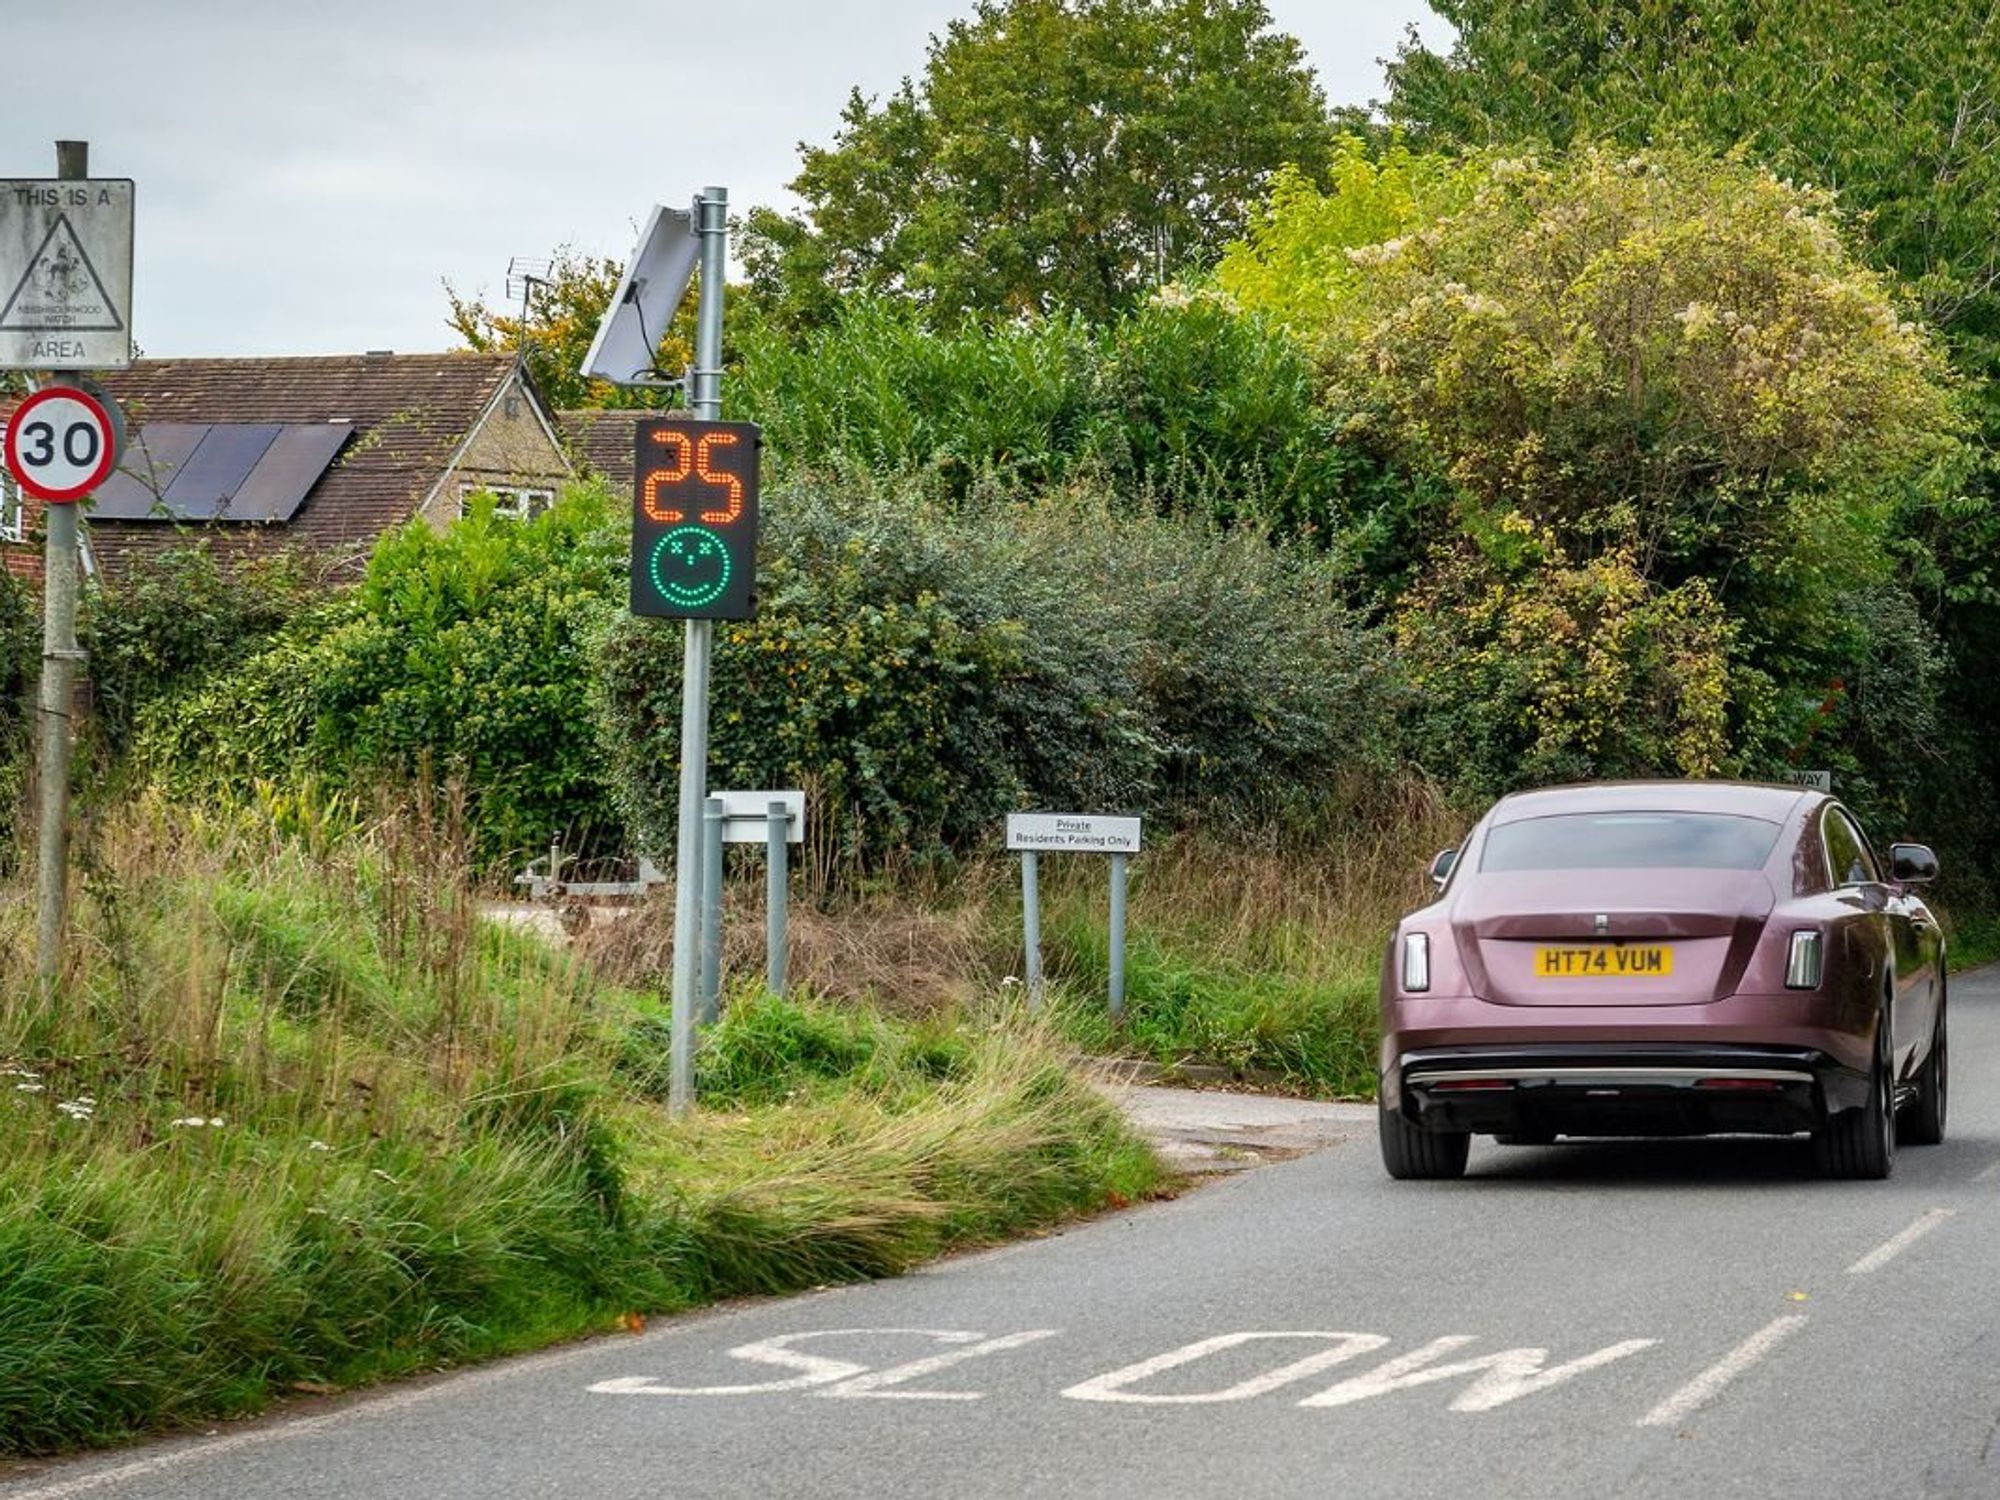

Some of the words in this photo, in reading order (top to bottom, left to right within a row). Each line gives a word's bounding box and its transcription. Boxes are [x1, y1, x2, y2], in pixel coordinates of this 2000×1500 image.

[14, 189, 59, 206] THIS
[69, 189, 87, 206] IS
[98, 189, 111, 206] A
[32, 341, 85, 358] AREA
[23, 421, 99, 468] 30
[644, 431, 742, 523] 25
[1056, 819, 1091, 831] Private
[1015, 833, 1064, 844] Residents
[1069, 835, 1105, 846] Parking
[1108, 837, 1131, 848] Only
[1546, 951, 1607, 972] HT74
[1615, 950, 1661, 971] VUM
[586, 1329, 1664, 1412] SLOW
